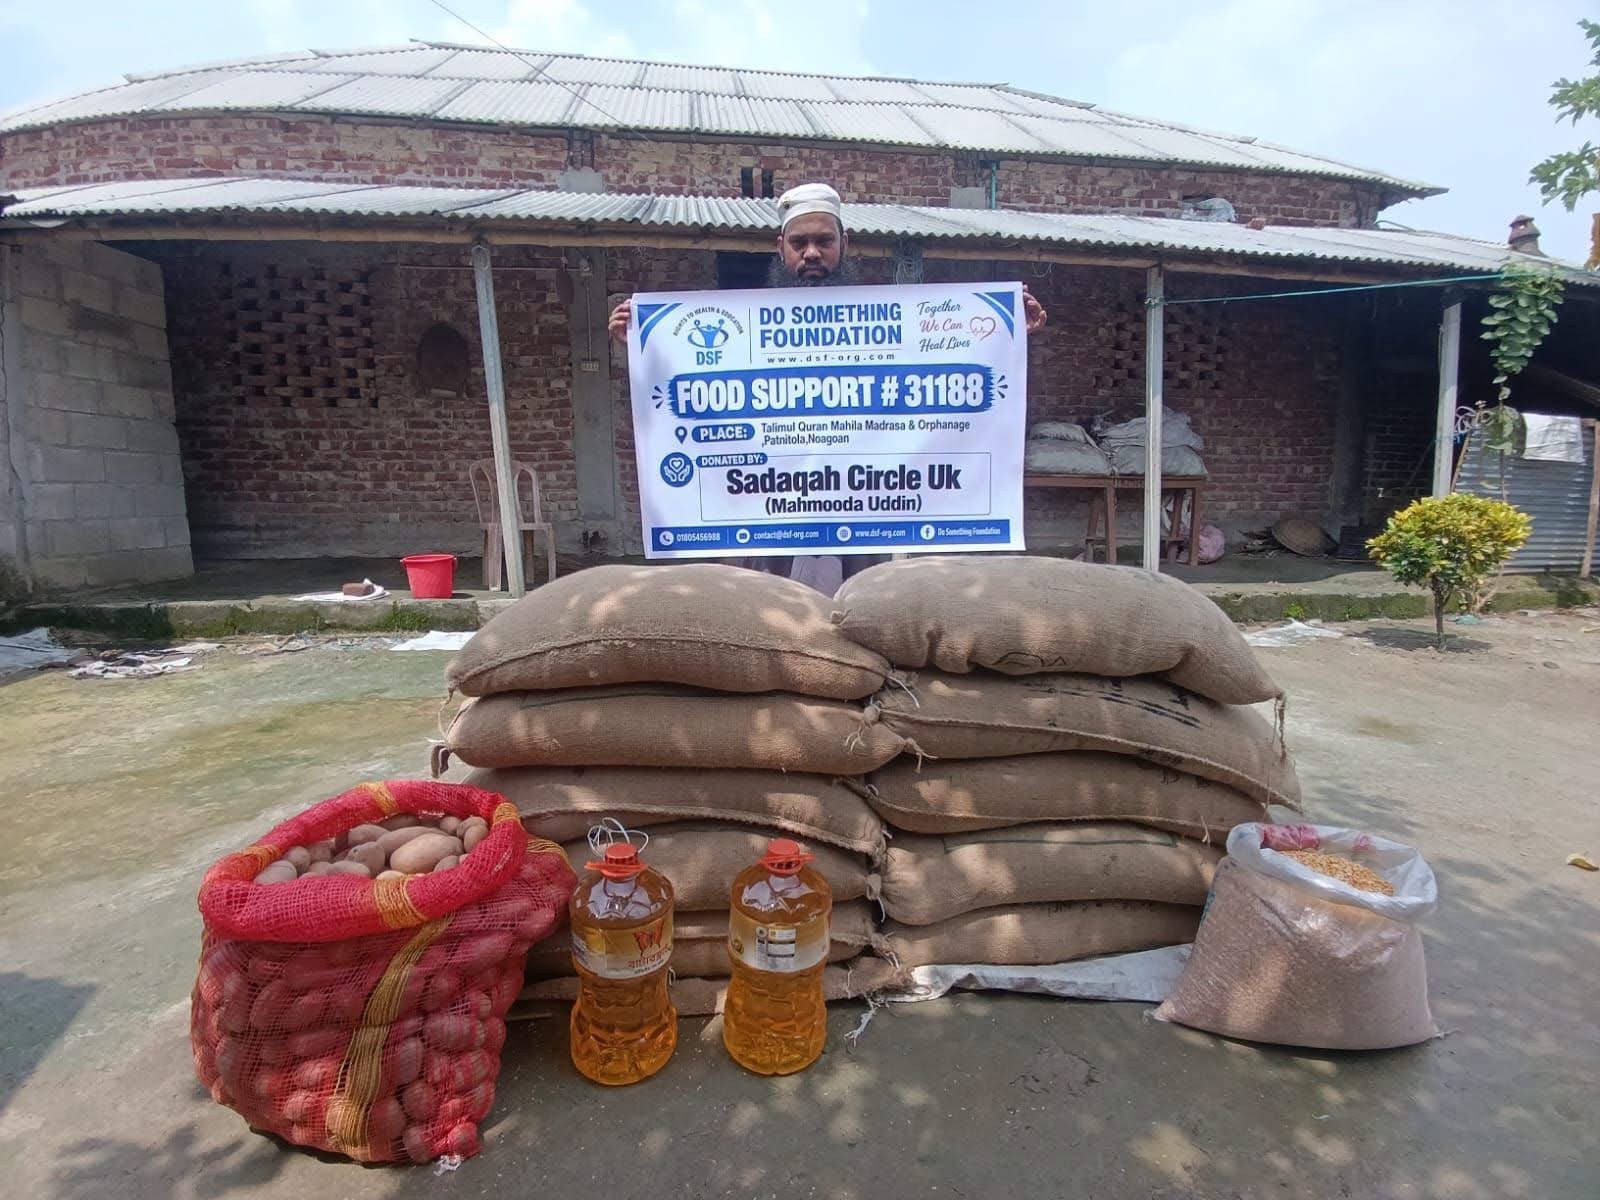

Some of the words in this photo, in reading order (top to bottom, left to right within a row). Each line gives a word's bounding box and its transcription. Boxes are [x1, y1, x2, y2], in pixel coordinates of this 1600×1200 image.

[759, 306, 785, 325] DO
[791, 302, 902, 325] SOMETHING
[916, 298, 962, 318] Together
[686, 311, 694, 319] TO
[694, 306, 715, 315] HEALTH
[721, 309, 744, 335] EDUCATION
[919, 320, 939, 333] We
[942, 318, 963, 332] Can
[760, 325, 902, 349] FOUNDATION
[919, 338, 944, 353] Heal
[945, 336, 971, 349] Lives
[696, 350, 723, 366] DSF
[767, 353, 895, 364] www.dsf-org.com
[676, 379, 746, 414] FOOD
[751, 375, 875, 411] SUPPORT
[880, 375, 899, 407] #
[904, 373, 984, 407] 31188
[701, 426, 748, 441] PLACE:
[761, 423, 796, 434] Talimul
[798, 421, 828, 433] Quran
[830, 420, 863, 431] Mahila
[865, 419, 906, 431] Madrasa
[908, 419, 915, 430] &
[918, 418, 971, 432] Orphanage
[701, 455, 745, 467] DONATED
[748, 454, 764, 465] BY:
[726, 465, 841, 497] Sadaqah
[847, 464, 921, 491] Circle
[927, 463, 962, 490] Uk
[765, 496, 864, 516] (Mahmooda
[868, 494, 923, 513] Uddin)
[753, 531, 819, 540] contact@dsf-org.com
[855, 528, 906, 538] www.dsf-org.com
[937, 527, 945, 536] Do
[945, 527, 972, 537] Something
[972, 526, 1001, 535] Foundation
